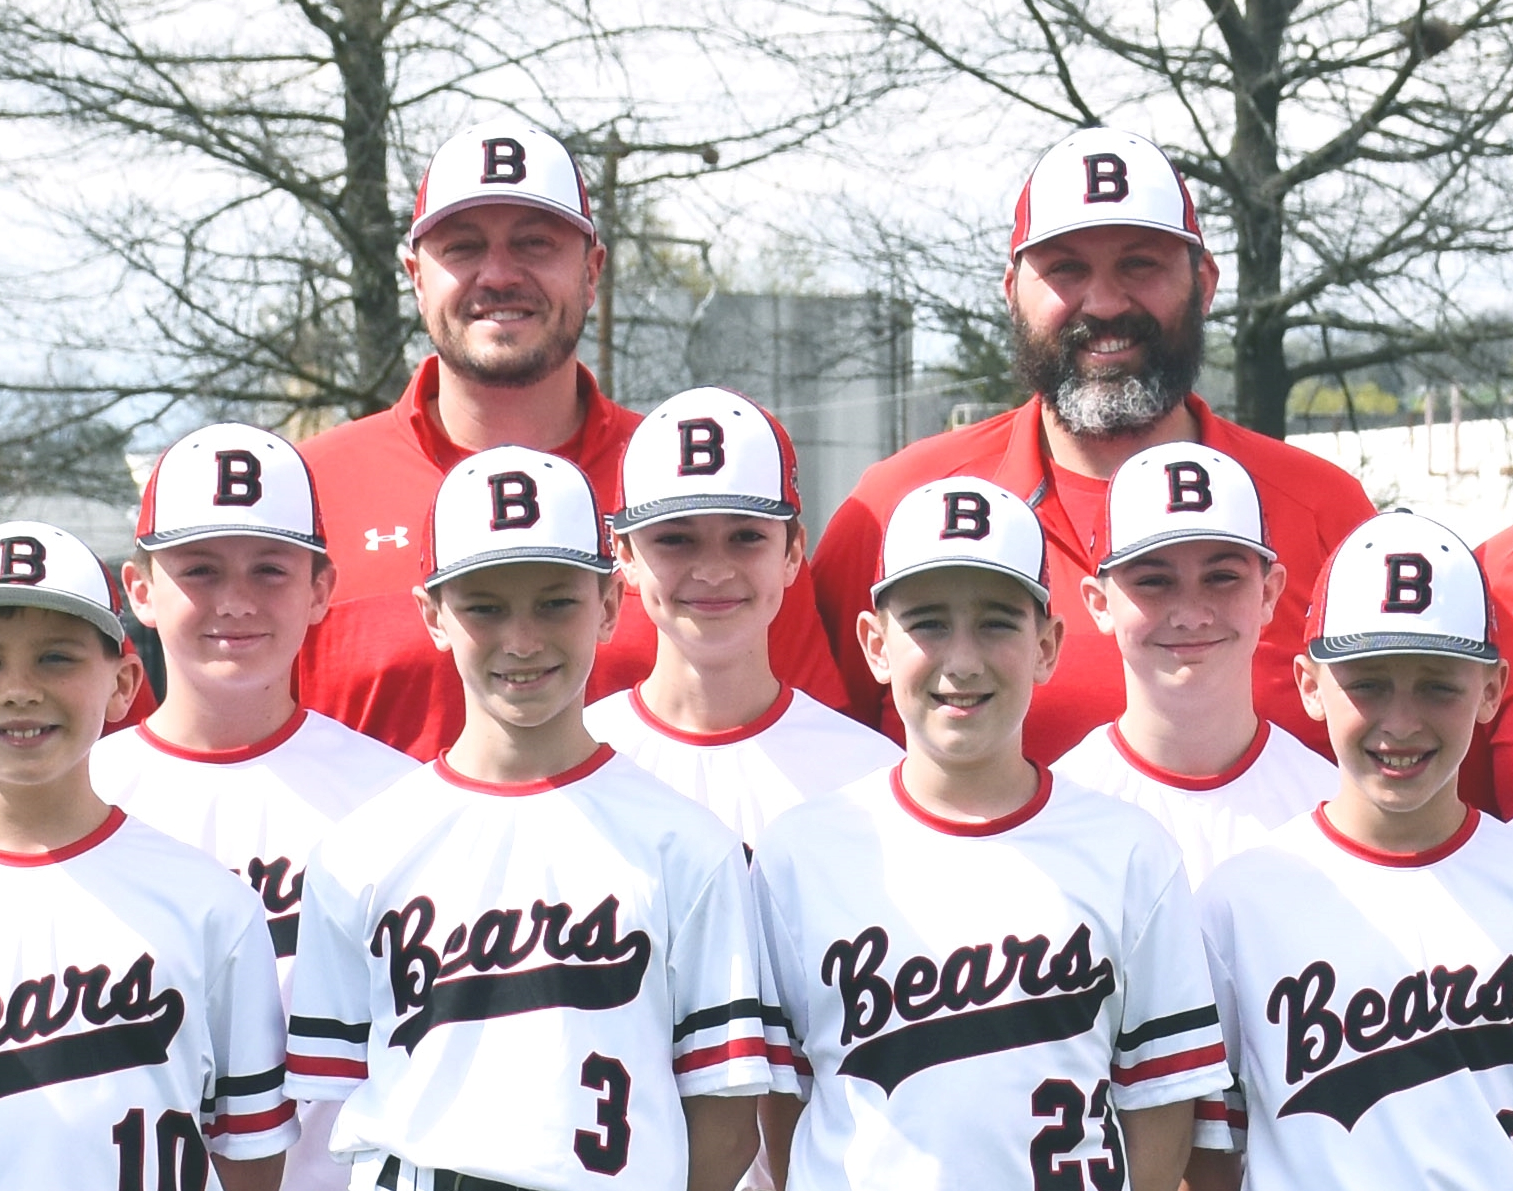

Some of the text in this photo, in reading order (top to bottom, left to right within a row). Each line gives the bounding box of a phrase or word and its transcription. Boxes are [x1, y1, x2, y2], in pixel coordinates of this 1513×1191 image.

[480, 137, 527, 185] B
[1082, 152, 1129, 205] B
[677, 417, 726, 477] B
[212, 449, 263, 507] B
[487, 470, 541, 532] B
[1164, 460, 1213, 514] B
[938, 491, 991, 541] B
[1380, 552, 1433, 615] B
[370, 894, 651, 1016] Bears
[821, 922, 1116, 1047] Bears
[573, 1051, 632, 1177] 3
